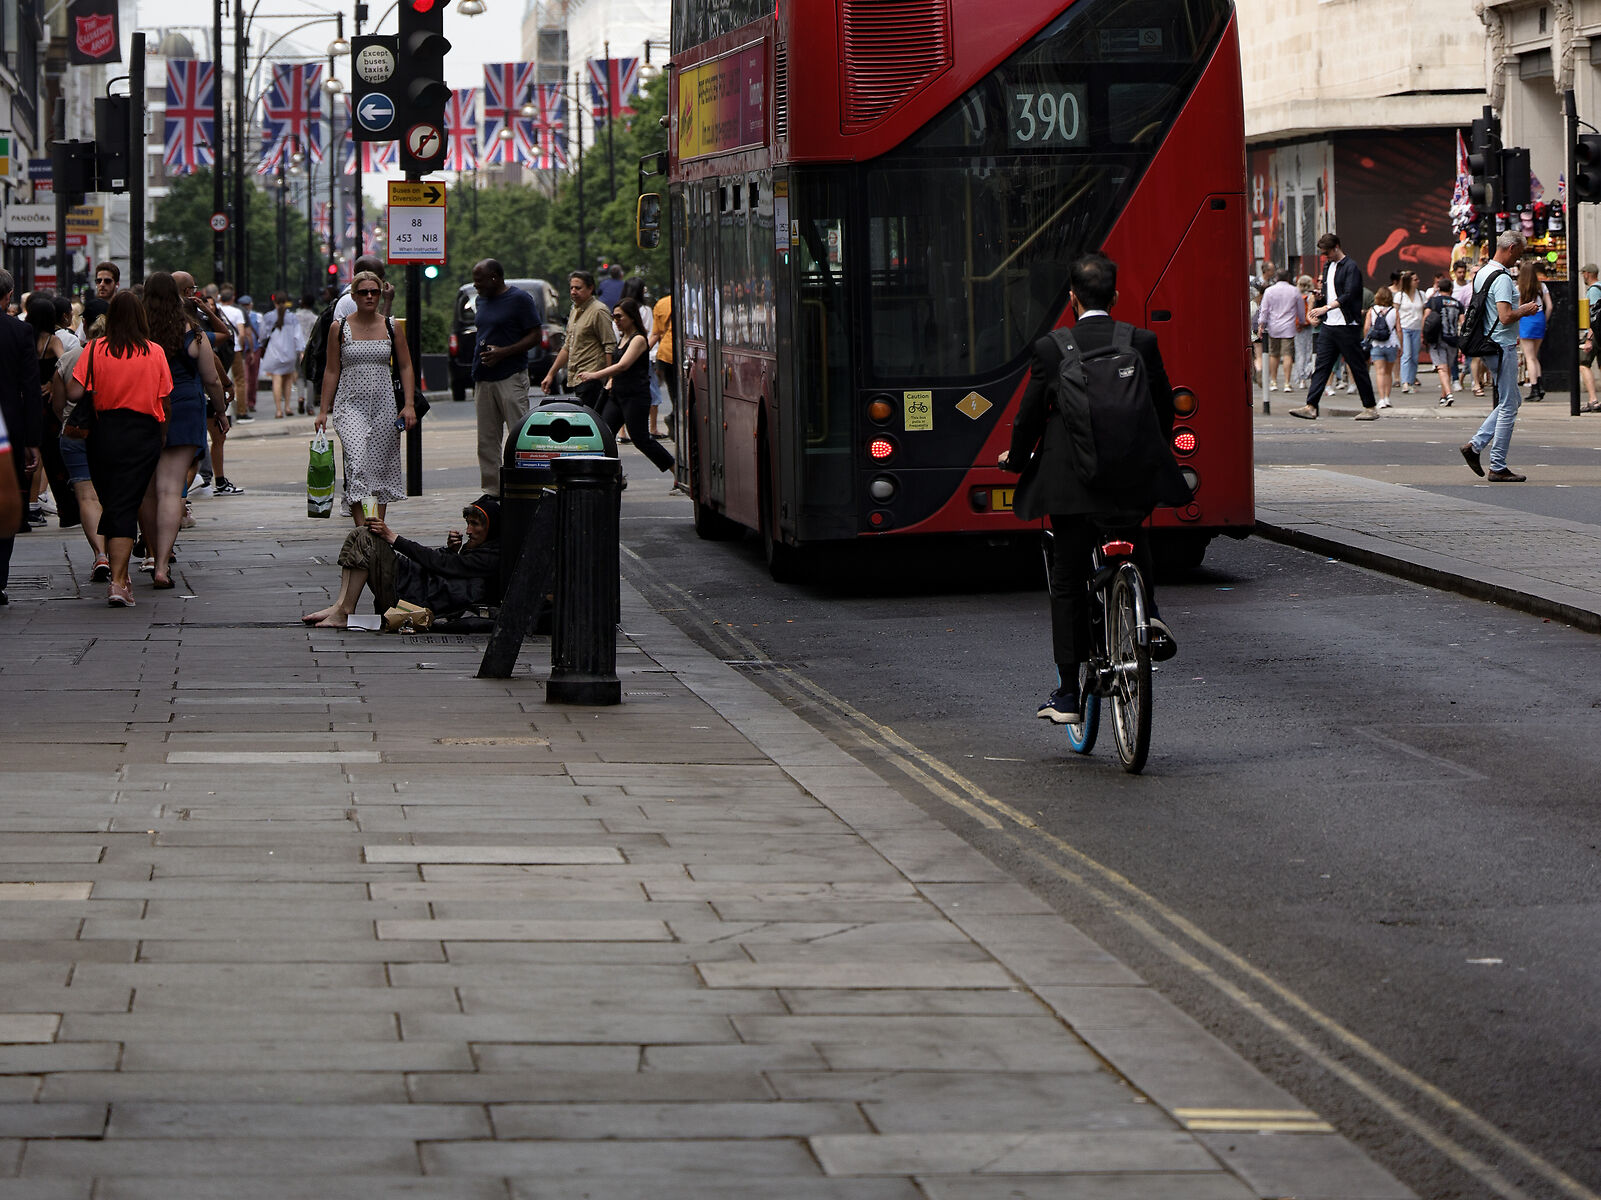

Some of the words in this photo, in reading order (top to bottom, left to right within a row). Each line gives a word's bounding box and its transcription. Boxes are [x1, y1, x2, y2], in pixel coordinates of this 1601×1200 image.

[1016, 92, 1079, 142] 390
[412, 218, 422, 227] 88
[396, 234, 412, 242] 453
[422, 234, 438, 242] N18
